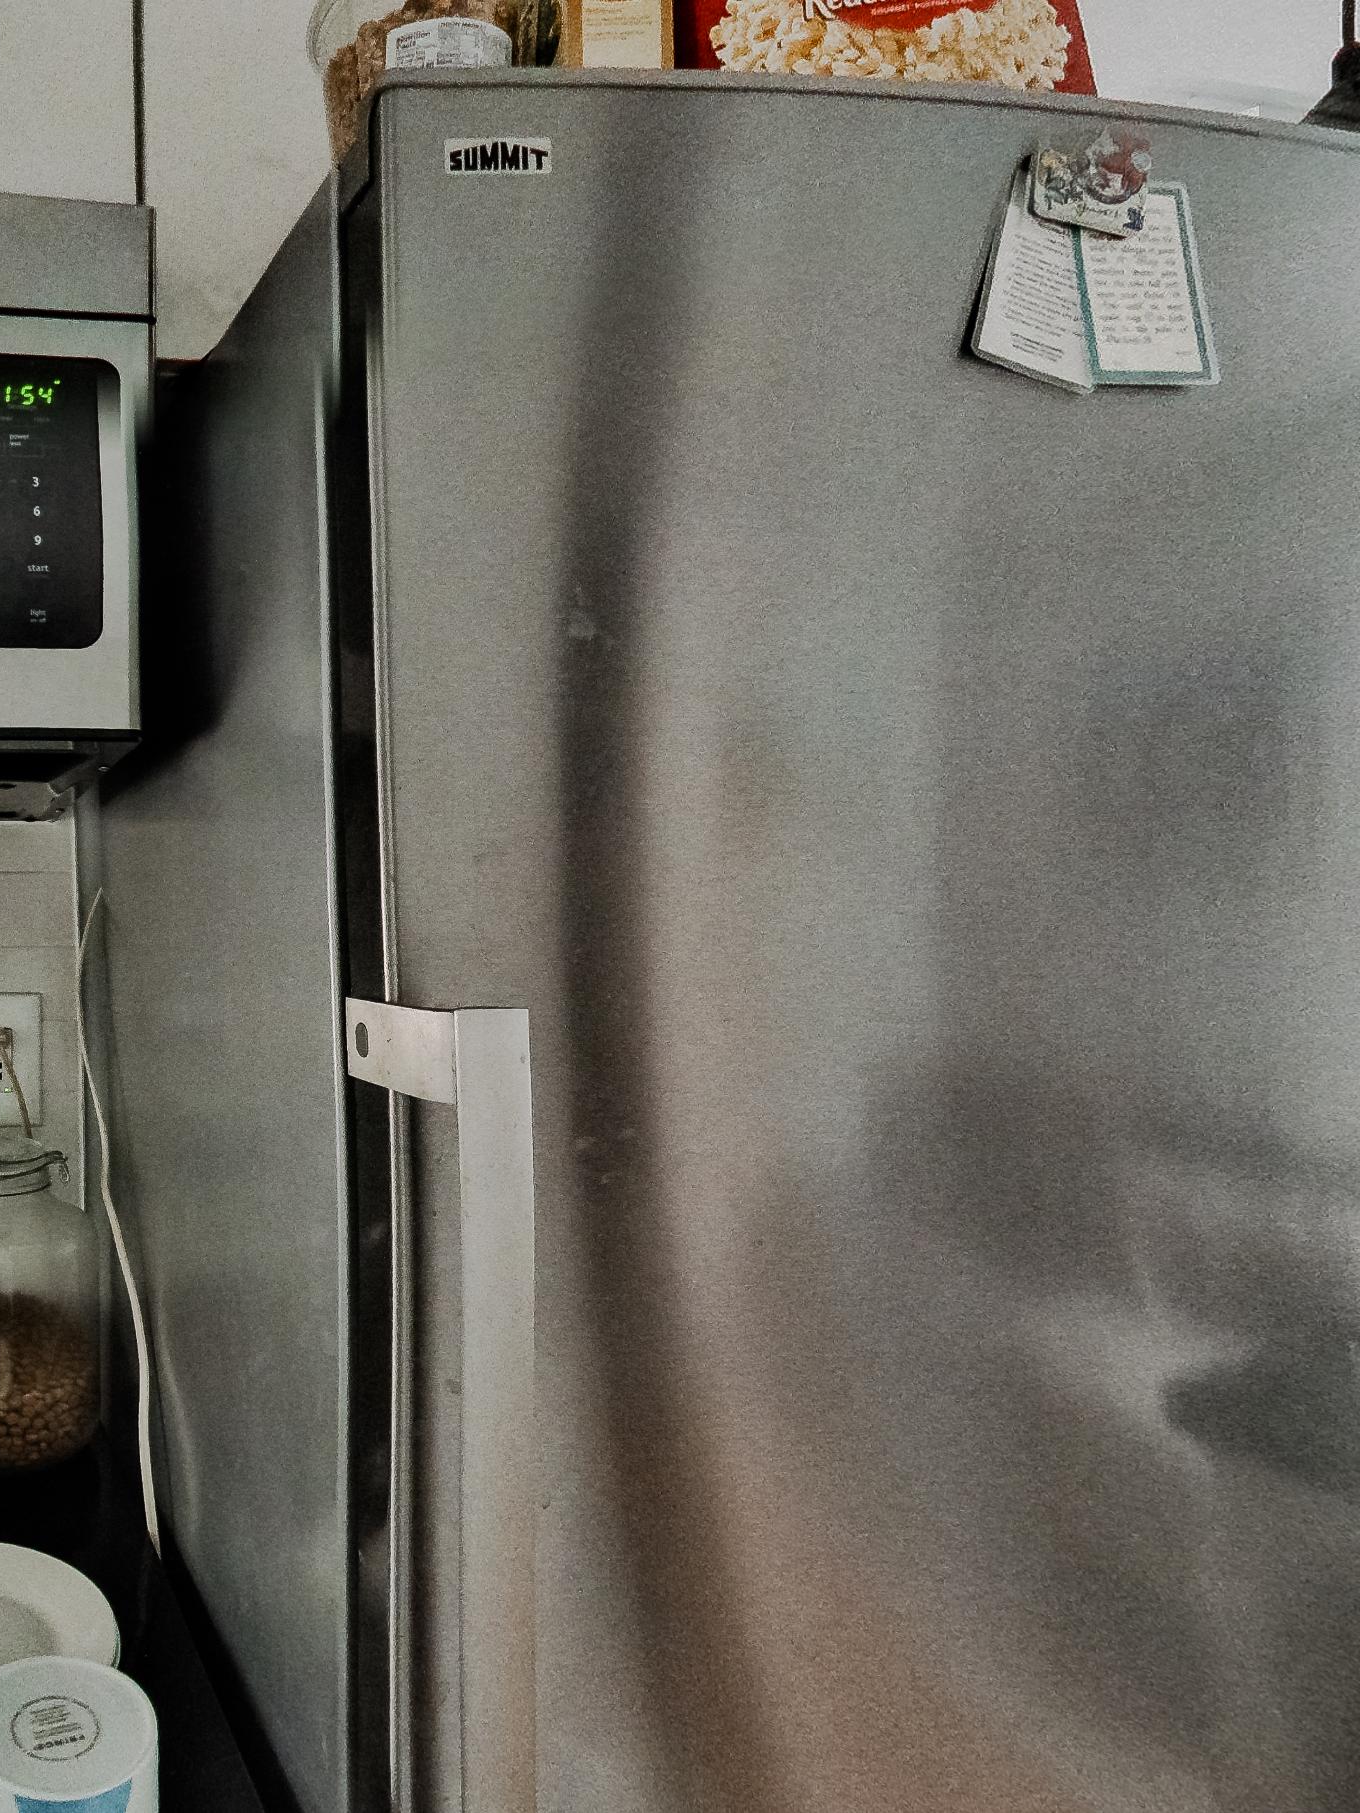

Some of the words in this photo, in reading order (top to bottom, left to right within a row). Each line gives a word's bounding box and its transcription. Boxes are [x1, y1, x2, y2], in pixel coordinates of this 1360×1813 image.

[449, 141, 549, 171] SUMMIT
[9, 433, 30, 441] power
[32, 477, 40, 488] 3
[33, 506, 41, 516] 6
[34, 535, 42, 546] 9
[27, 563, 49, 572] start
